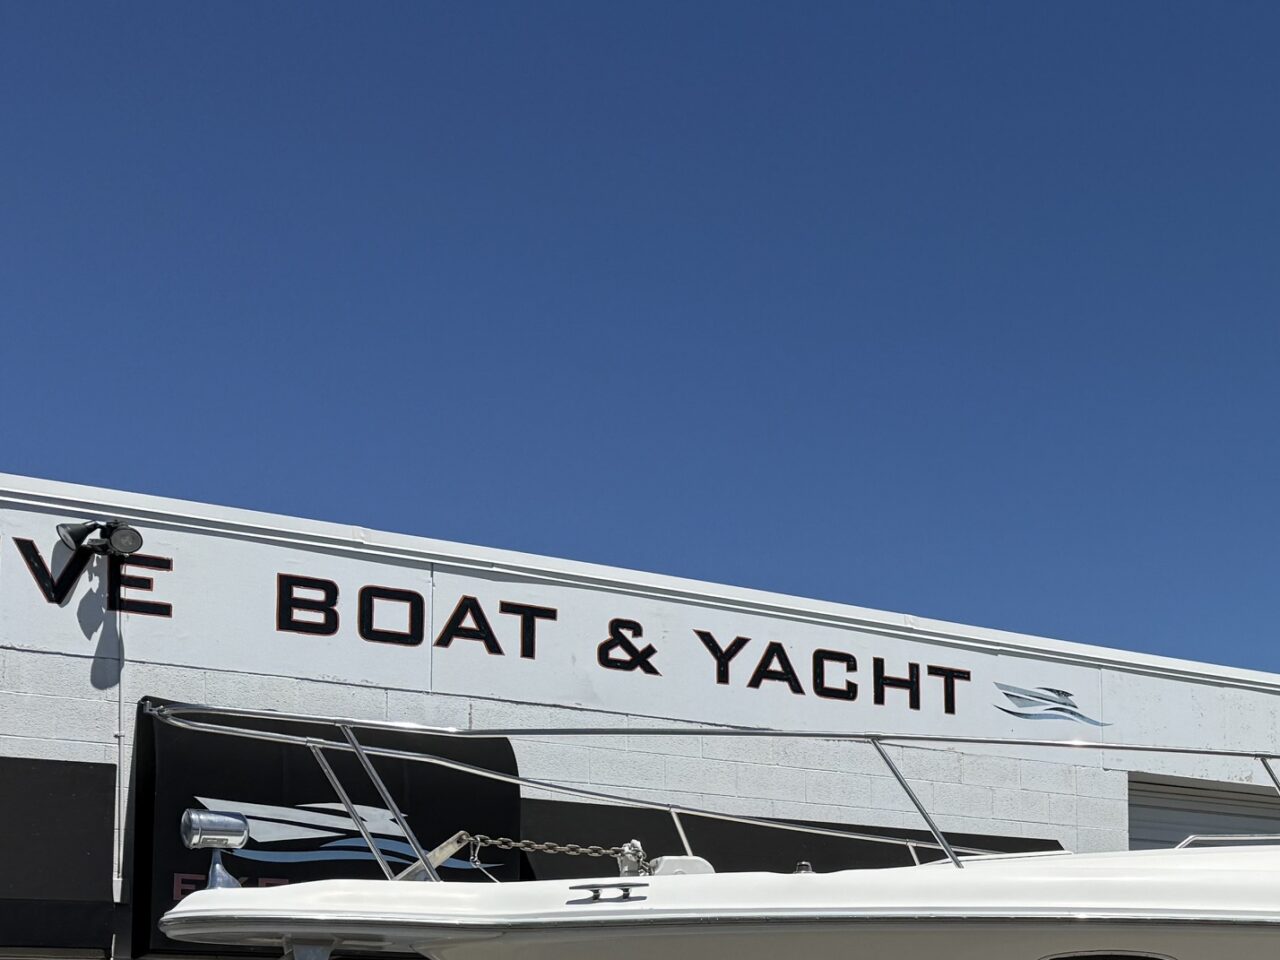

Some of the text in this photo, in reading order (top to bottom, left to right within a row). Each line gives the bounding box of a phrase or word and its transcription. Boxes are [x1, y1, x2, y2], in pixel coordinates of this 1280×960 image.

[276, 572, 558, 660] BOAT
[597, 618, 662, 676] &
[693, 629, 970, 716] YACHT
